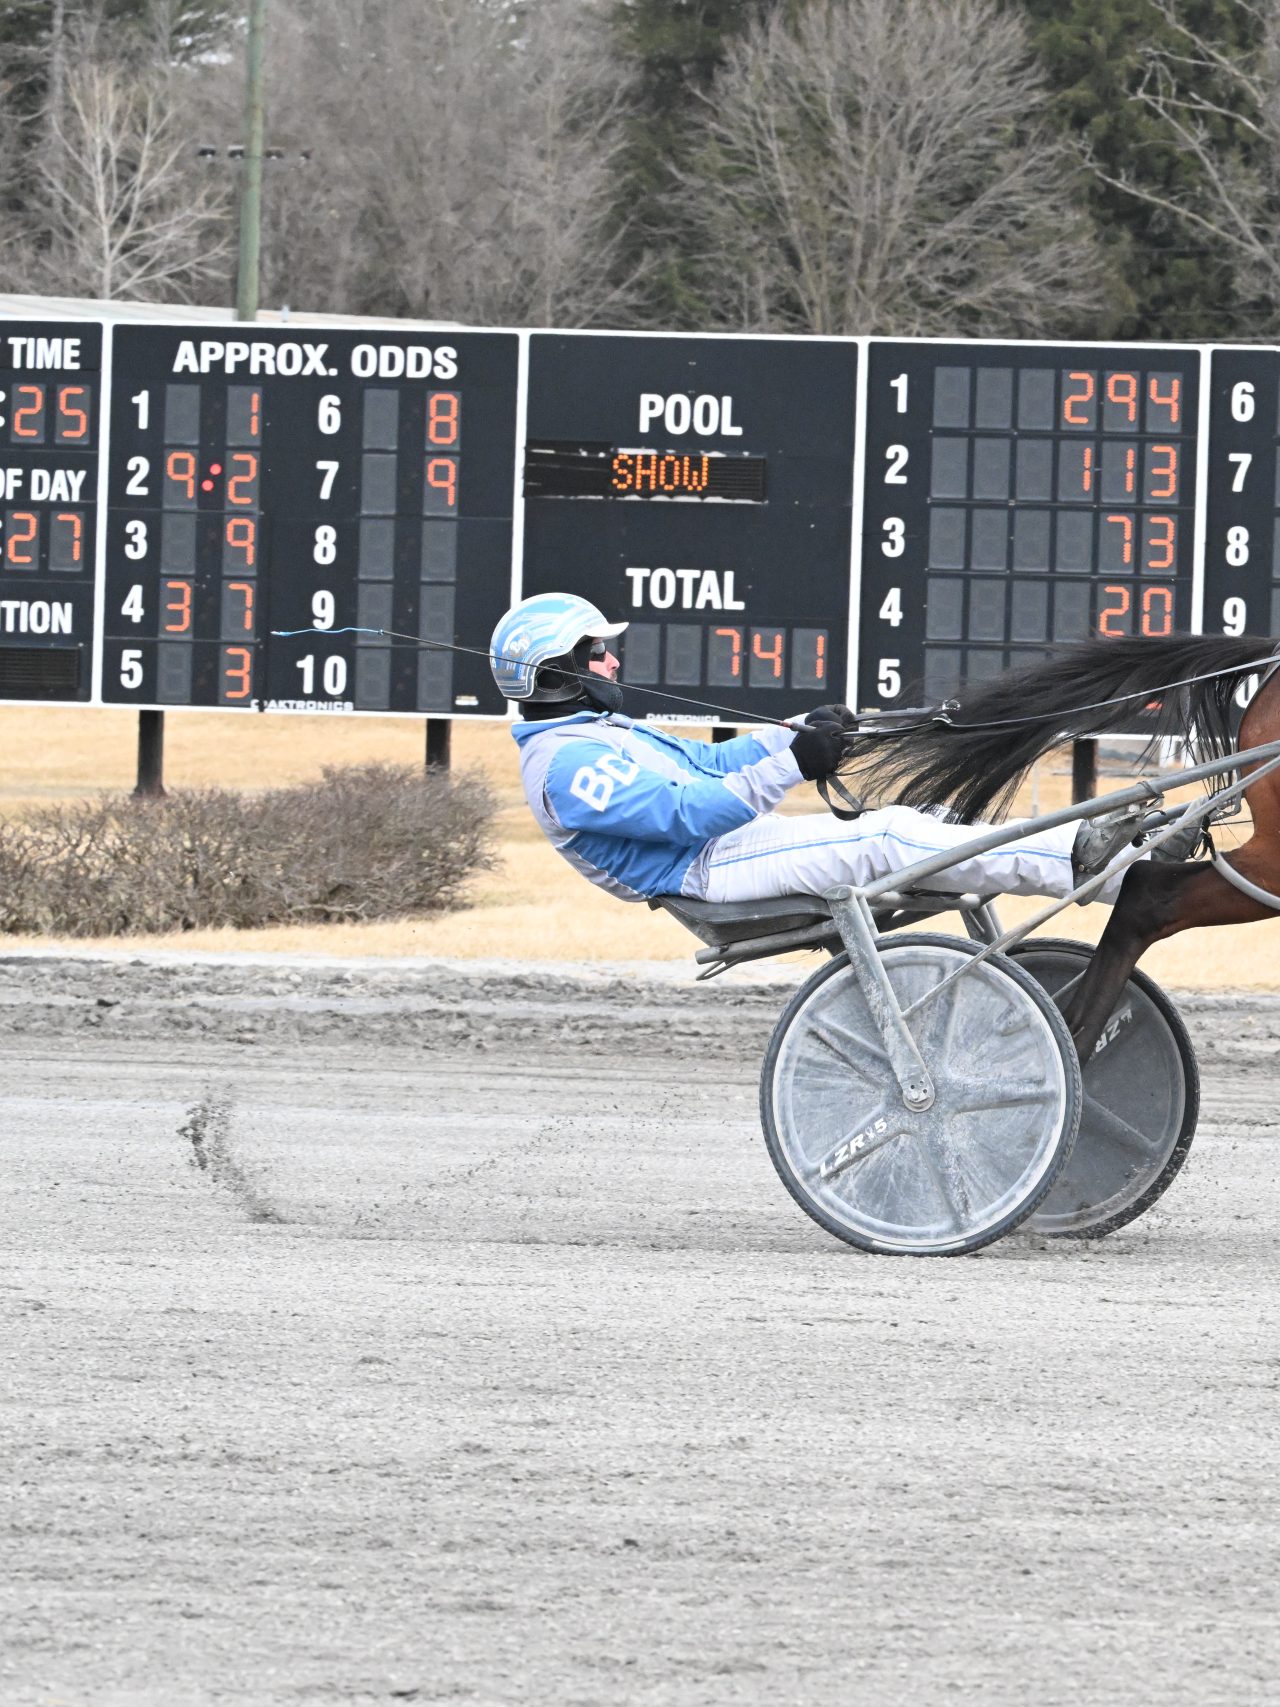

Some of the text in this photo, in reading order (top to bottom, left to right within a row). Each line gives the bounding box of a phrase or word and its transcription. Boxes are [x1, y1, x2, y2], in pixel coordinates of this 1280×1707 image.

[8, 337, 81, 370] TIME
[173, 341, 457, 380] APPROX. ODDS
[132, 390, 150, 430] 1
[890, 374, 908, 413] 1
[1064, 373, 1180, 424] 294
[1231, 382, 1255, 422] 6
[251, 394, 259, 435] 1
[318, 395, 341, 434] 6
[428, 393, 458, 444] 8
[639, 394, 743, 436] POOL
[126, 456, 149, 495] 2
[316, 461, 339, 499] 7
[427, 458, 456, 505] 9
[612, 453, 709, 491] SHOW
[884, 445, 909, 484] 2
[1083, 445, 1177, 497] 113
[1228, 453, 1252, 492] 7
[31, 469, 87, 502] DAY
[125, 521, 148, 560] 3
[226, 519, 255, 565] 9
[314, 525, 337, 564] 8
[882, 517, 906, 557] 3
[1107, 516, 1175, 568] 73
[1226, 526, 1249, 566] 8
[121, 585, 144, 623] 4
[626, 568, 745, 610] TOTAL
[879, 588, 903, 626] 4
[312, 590, 335, 629] 9
[1100, 586, 1172, 637] 20
[1223, 597, 1247, 637] 9
[120, 650, 143, 689] 5
[716, 628, 825, 678] 741
[226, 648, 251, 699] 3
[297, 655, 347, 695] 10
[878, 659, 901, 698] 5
[569, 753, 640, 812] BD
